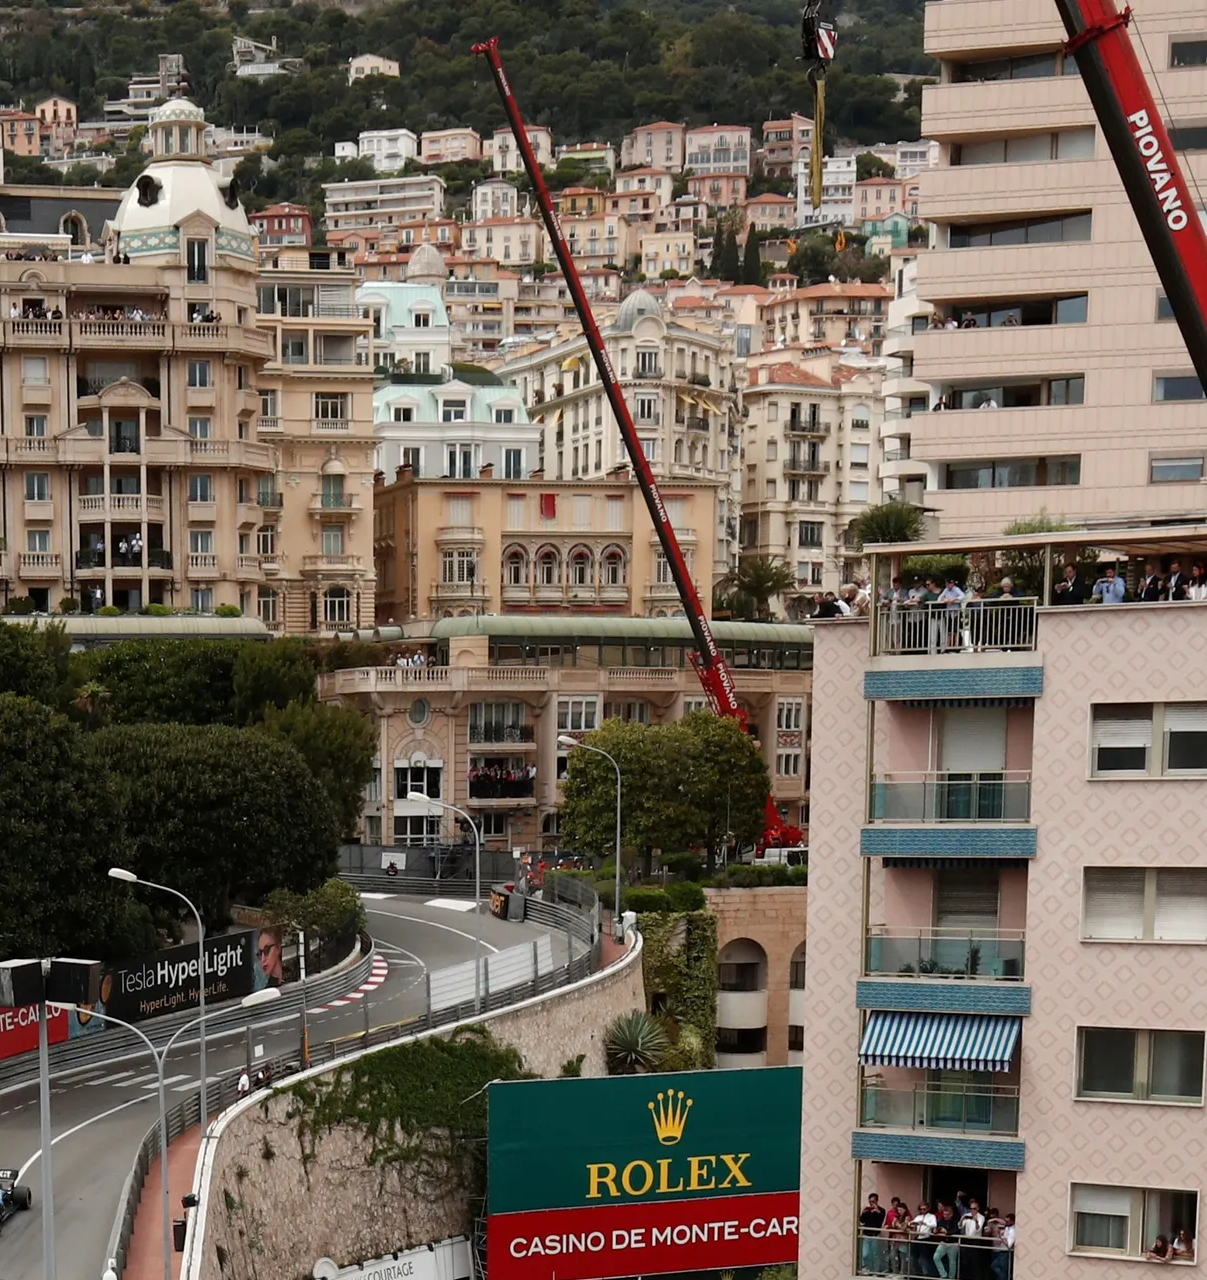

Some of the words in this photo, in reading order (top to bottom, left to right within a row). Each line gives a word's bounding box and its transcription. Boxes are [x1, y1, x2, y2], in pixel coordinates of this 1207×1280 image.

[1127, 109, 1188, 231] PIOVANO
[600, 349, 617, 385] PIOVANO
[649, 483, 668, 523] PIOVANO
[697, 615, 717, 657] PIOVANO
[716, 663, 738, 709] PIOVANO
[118, 963, 155, 994] Tesla
[585, 1152, 753, 1199] ROLEX
[509, 1231, 605, 1258] CASINO
[611, 1228, 646, 1250] DE
